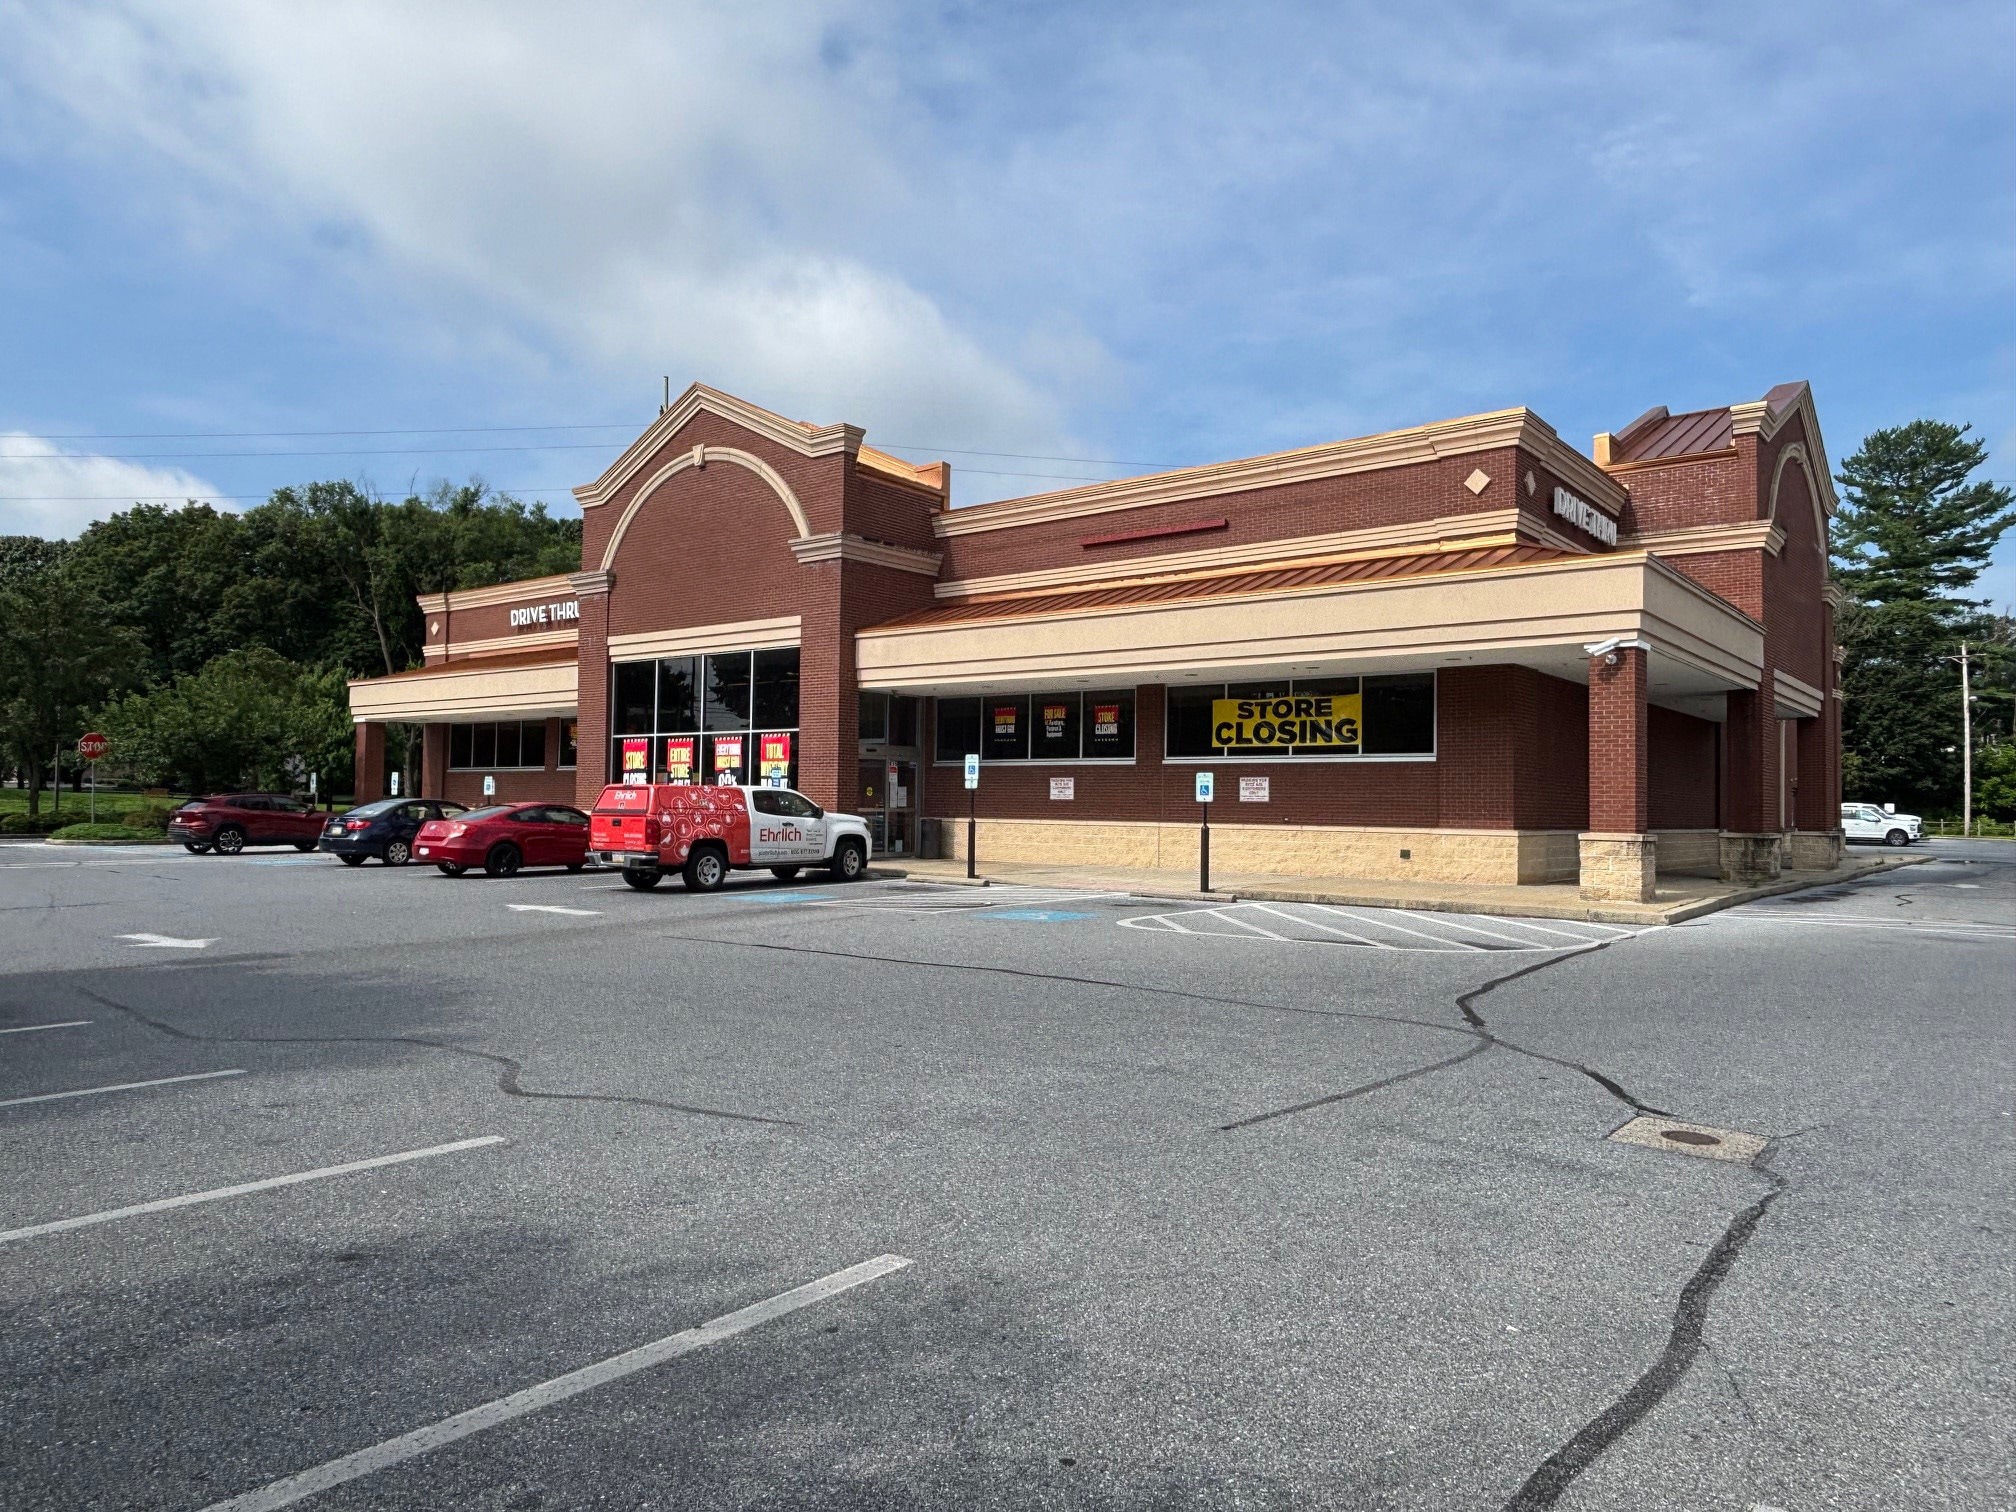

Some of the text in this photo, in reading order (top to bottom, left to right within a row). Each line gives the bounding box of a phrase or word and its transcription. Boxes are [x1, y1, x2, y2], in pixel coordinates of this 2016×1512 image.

[1554, 487, 1617, 546] DRIVE THRU
[510, 605, 547, 626] DRIVE
[1098, 711, 1115, 723] STORE
[1237, 698, 1333, 719] STORE
[1215, 718, 1359, 745] CLOSING
[669, 747, 691, 763] ENTIRE
[765, 743, 785, 759] TOTAL
[625, 751, 645, 770] STORE
[670, 763, 690, 779] STORE
[760, 827, 802, 842] Ehrlich
